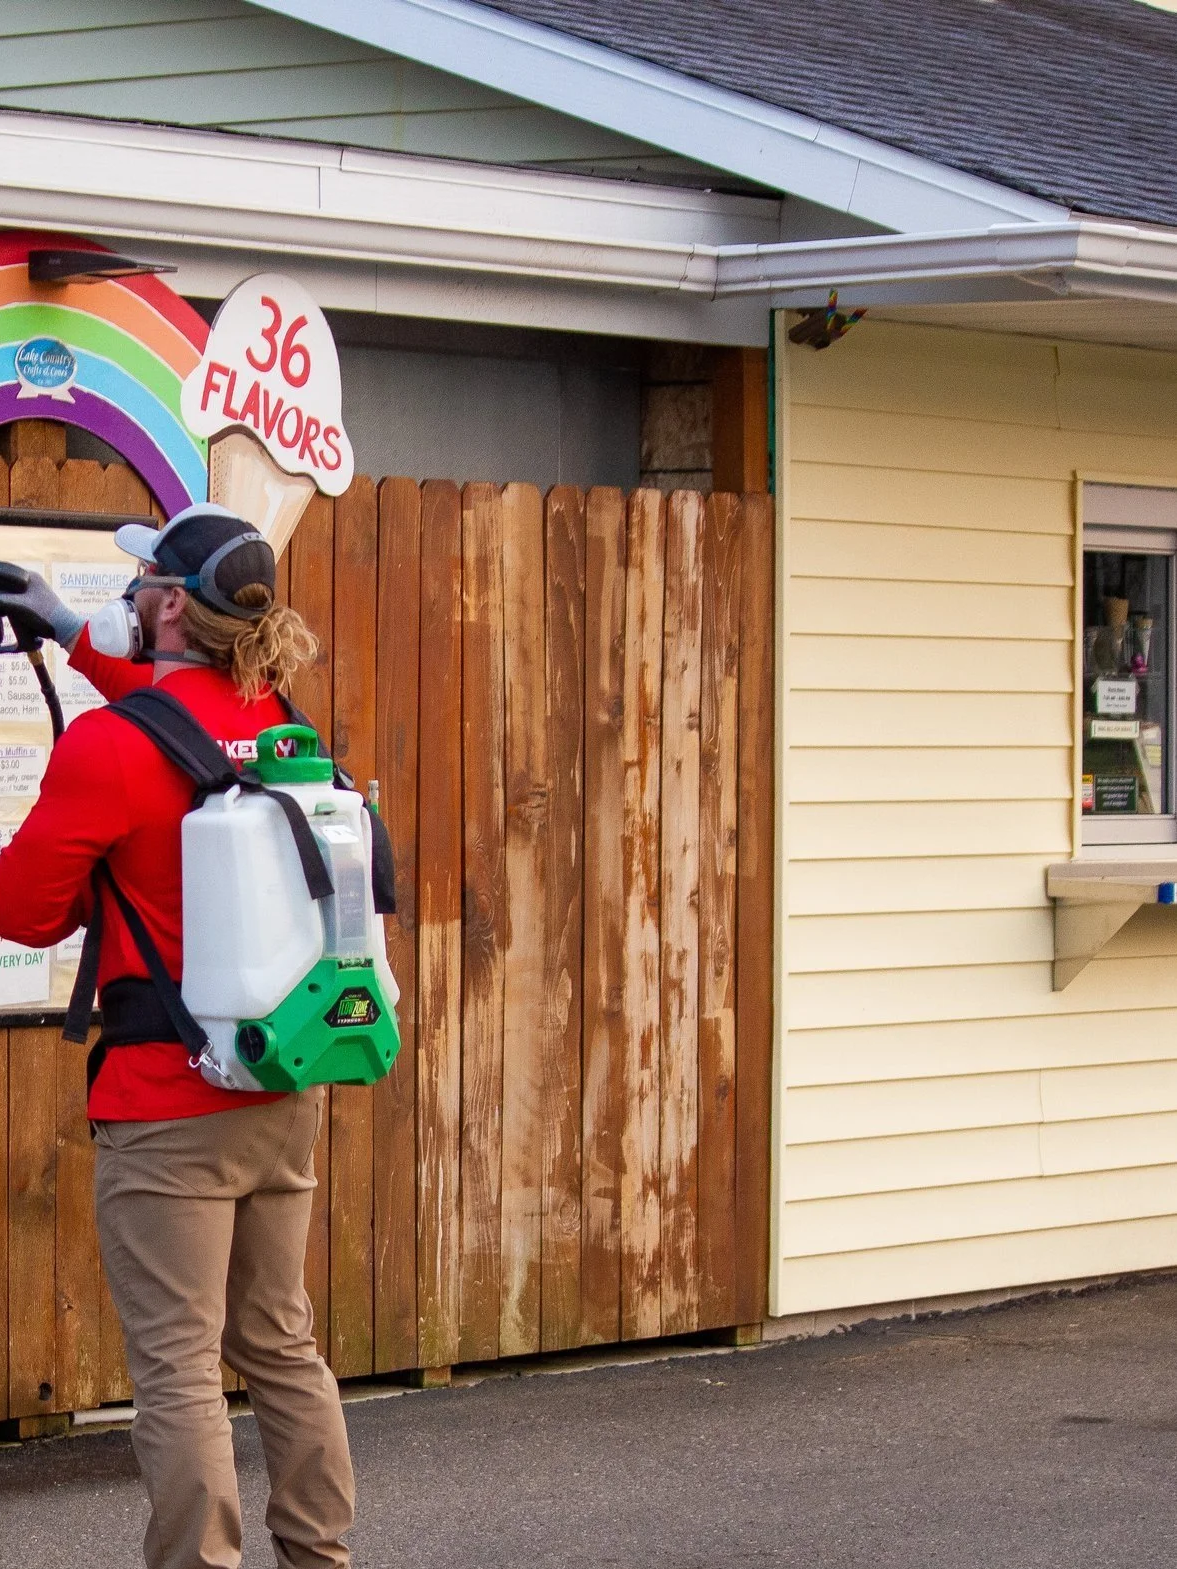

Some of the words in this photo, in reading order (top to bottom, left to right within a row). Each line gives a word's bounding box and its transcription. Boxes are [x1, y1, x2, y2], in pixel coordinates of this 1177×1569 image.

[246, 296, 310, 388] 36
[19, 348, 38, 364] Lake
[40, 351, 73, 368] Country
[24, 364, 42, 377] Crafts
[201, 361, 341, 470] FLAVORS
[60, 572, 128, 587] SANDWICHES
[8, 691, 41, 703] Sausage,
[23, 705, 39, 715] Ham
[6, 747, 27, 756] Muffin
[1, 760, 19, 769] $3.00
[7, 775, 19, 783] jelly,
[25, 951, 44, 965] DAY
